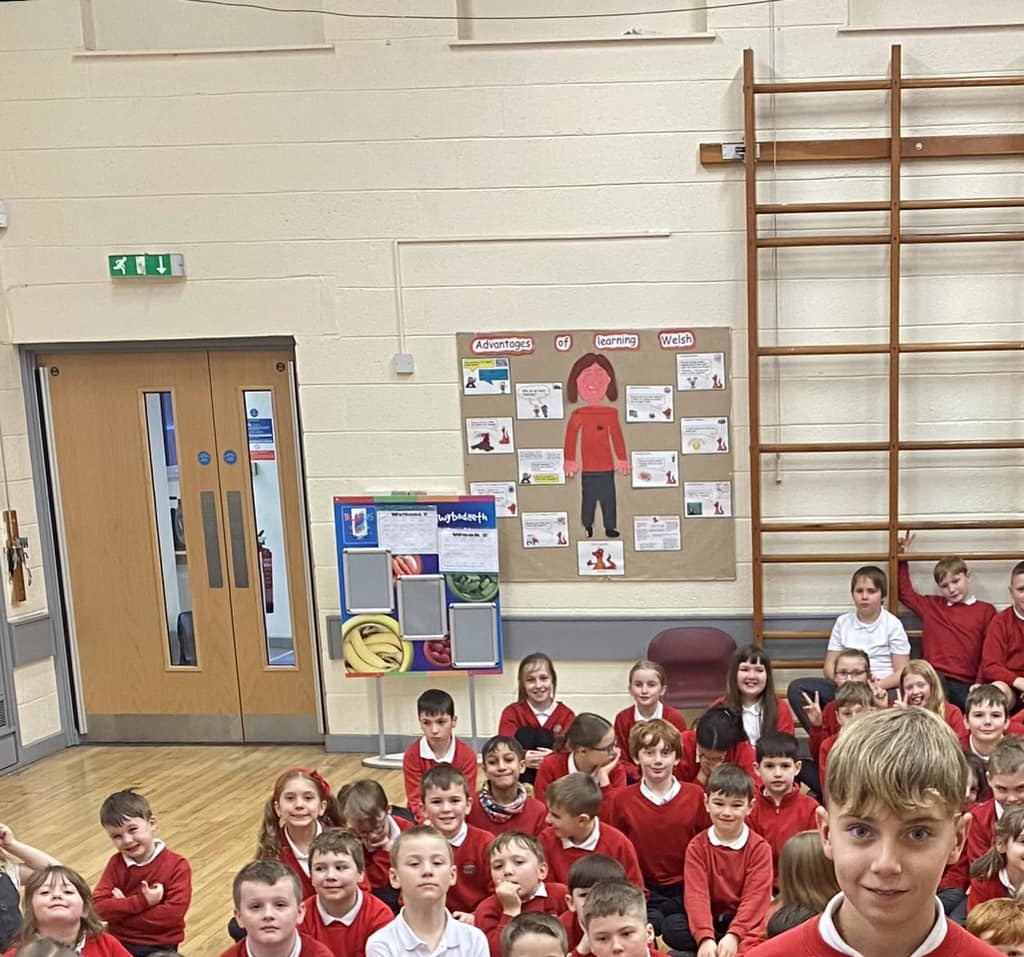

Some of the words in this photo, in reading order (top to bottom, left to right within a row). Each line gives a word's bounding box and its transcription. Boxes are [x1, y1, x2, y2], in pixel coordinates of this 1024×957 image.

[475, 338, 531, 351] Advantages
[557, 337, 569, 348] of
[597, 335, 637, 346] learning
[661, 333, 693, 345] Welsh
[437, 511, 488, 524] wybodaeth
